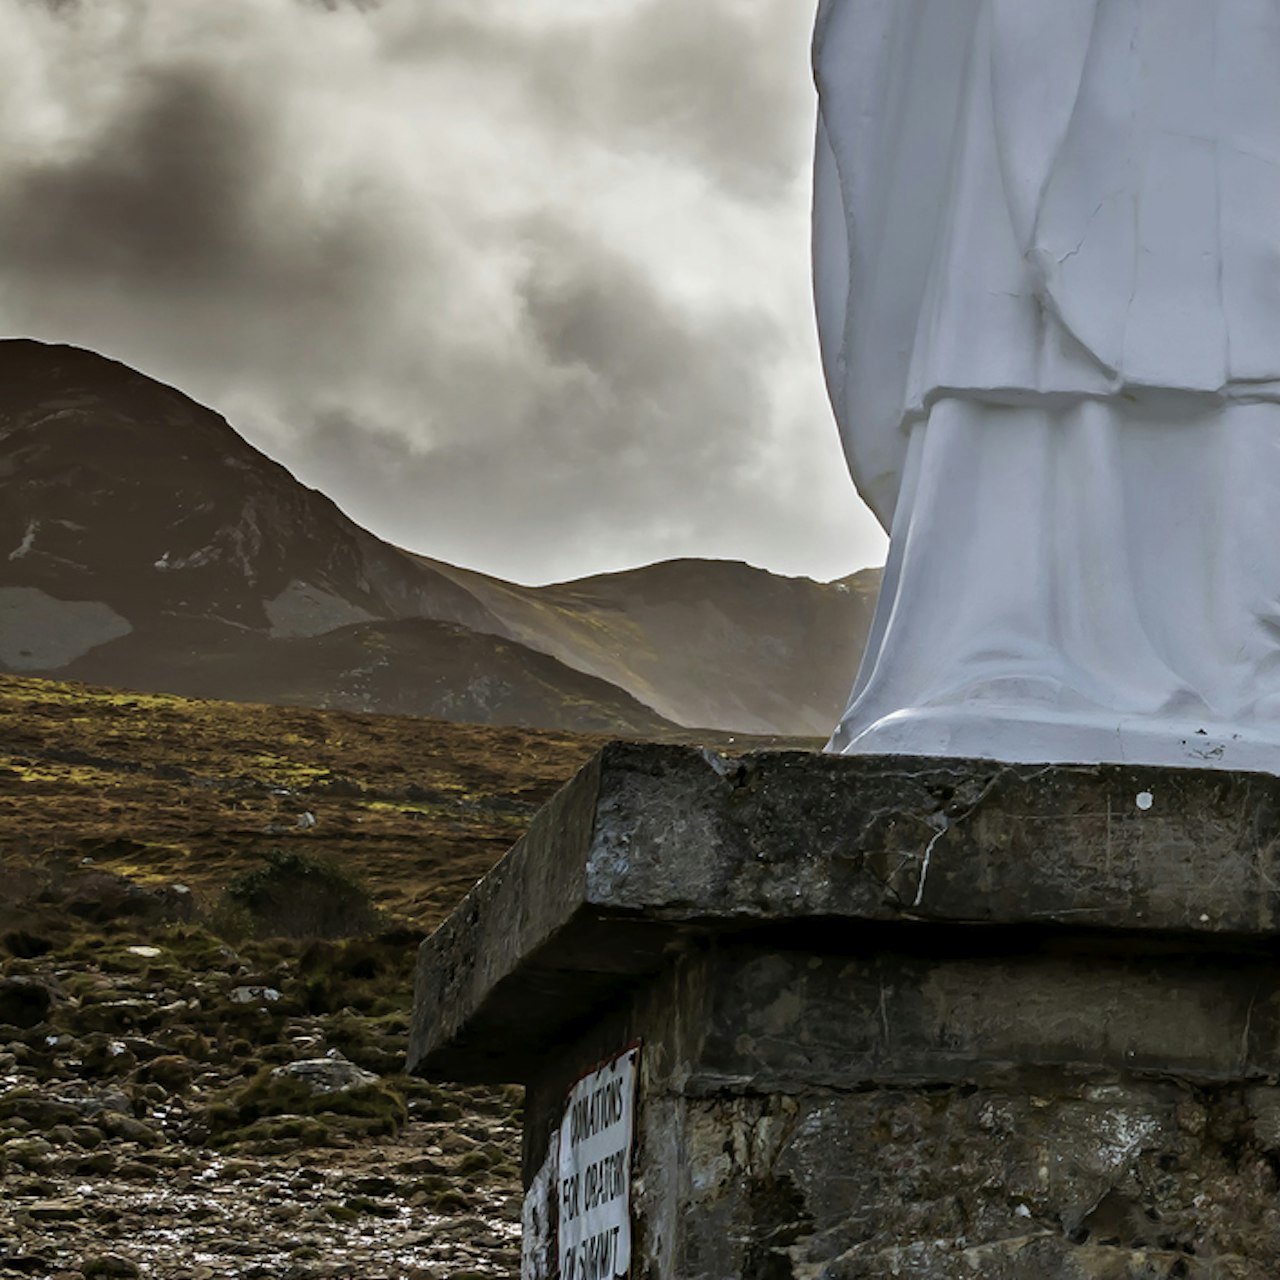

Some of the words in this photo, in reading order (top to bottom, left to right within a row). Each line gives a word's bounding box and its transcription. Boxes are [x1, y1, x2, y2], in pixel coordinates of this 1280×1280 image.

[570, 1076, 623, 1148] DONATIONS
[563, 1173, 579, 1220] FOR
[584, 1147, 627, 1211] ORATORY
